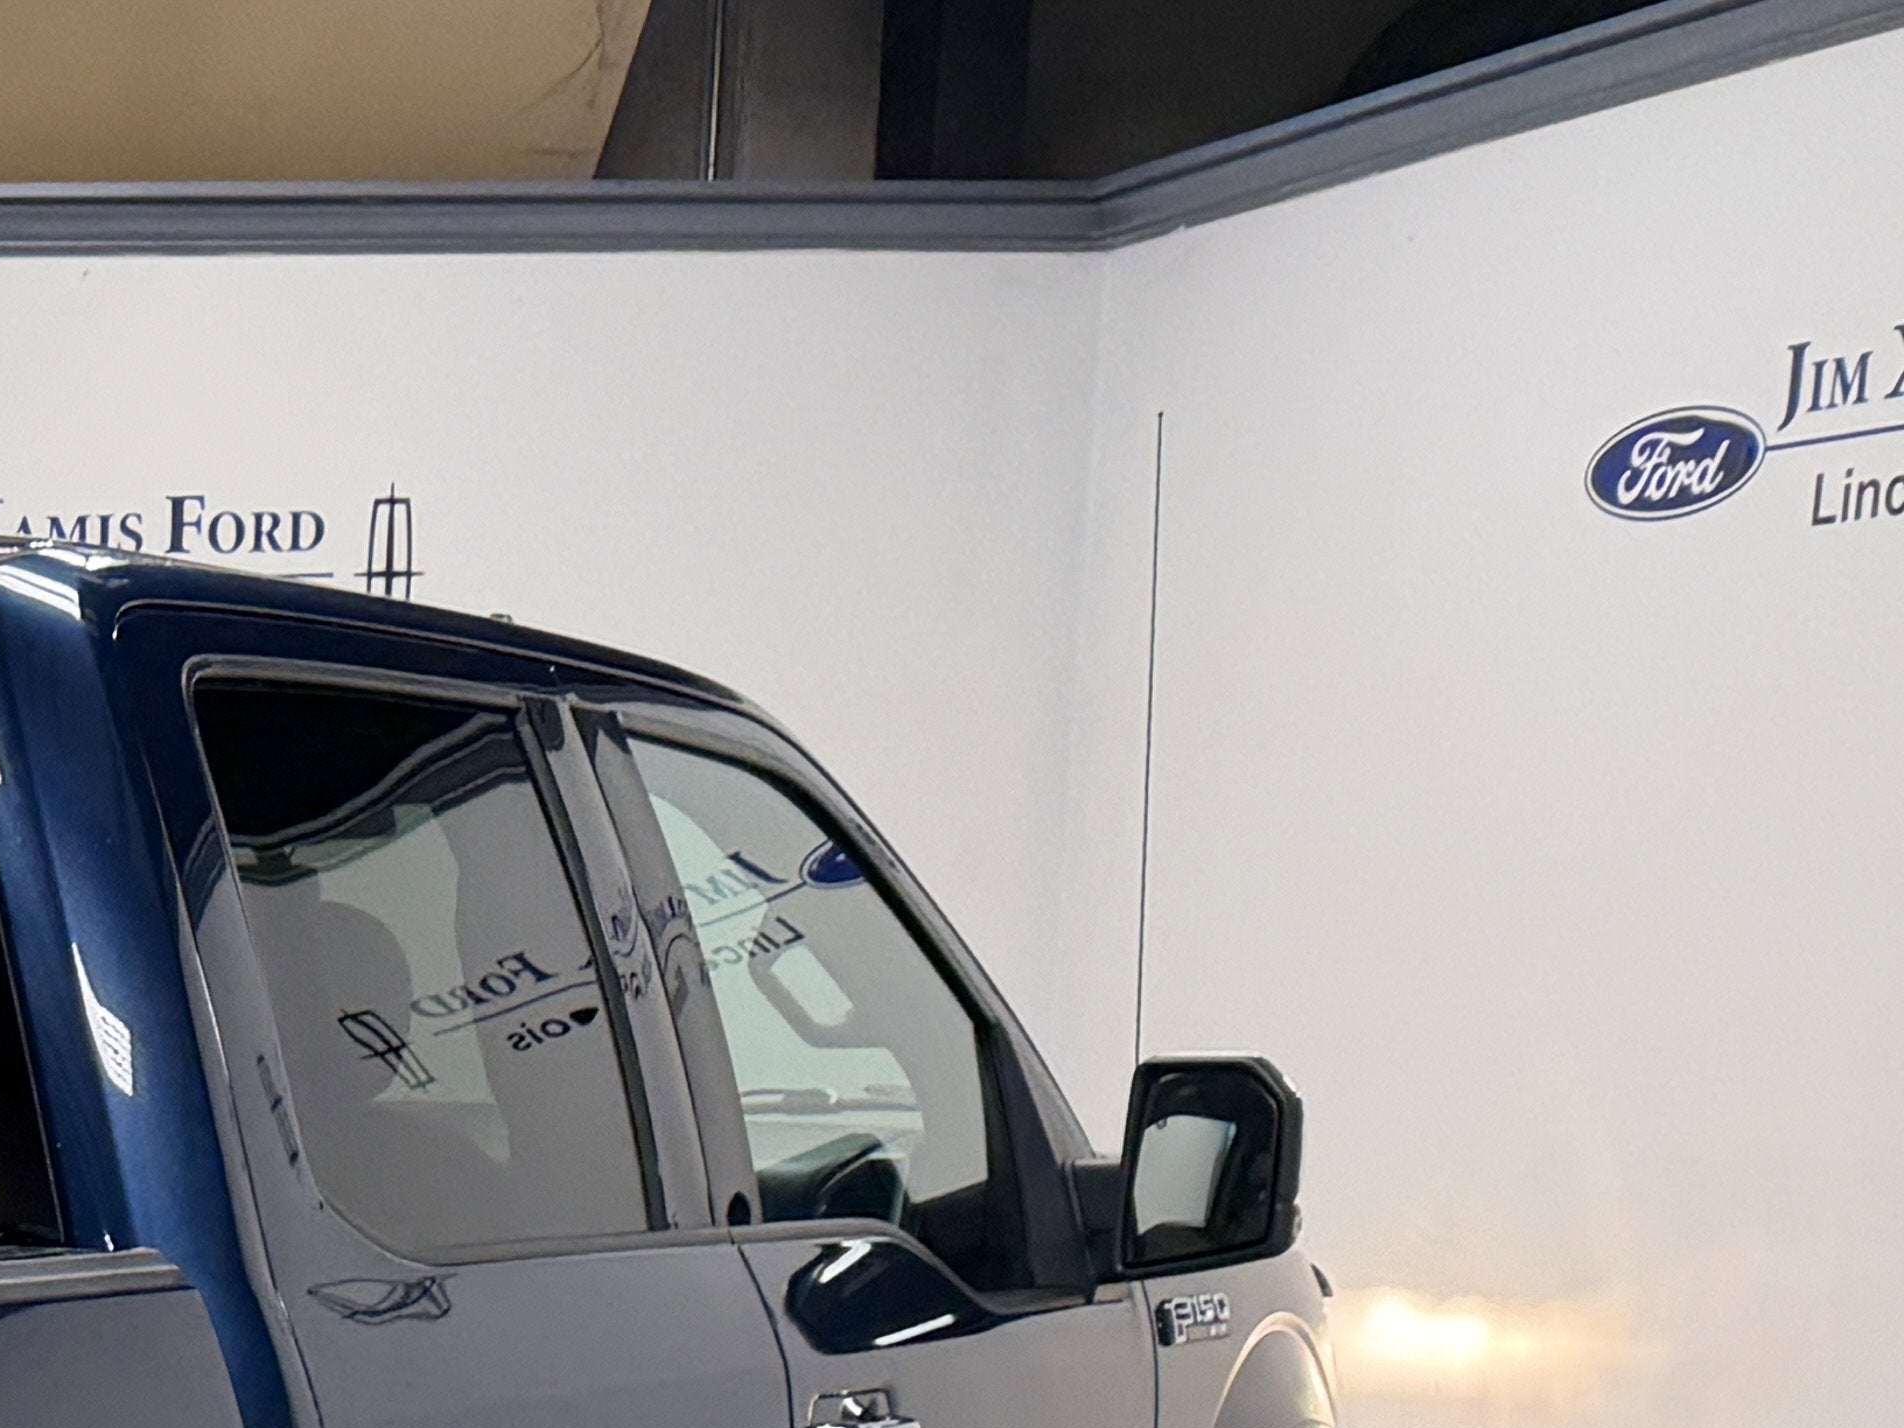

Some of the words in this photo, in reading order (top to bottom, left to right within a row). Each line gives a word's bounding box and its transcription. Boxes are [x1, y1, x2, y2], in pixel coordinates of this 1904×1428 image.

[1776, 341, 1874, 432] JIM
[1617, 427, 1730, 505] Ford
[164, 494, 326, 554] FORD
